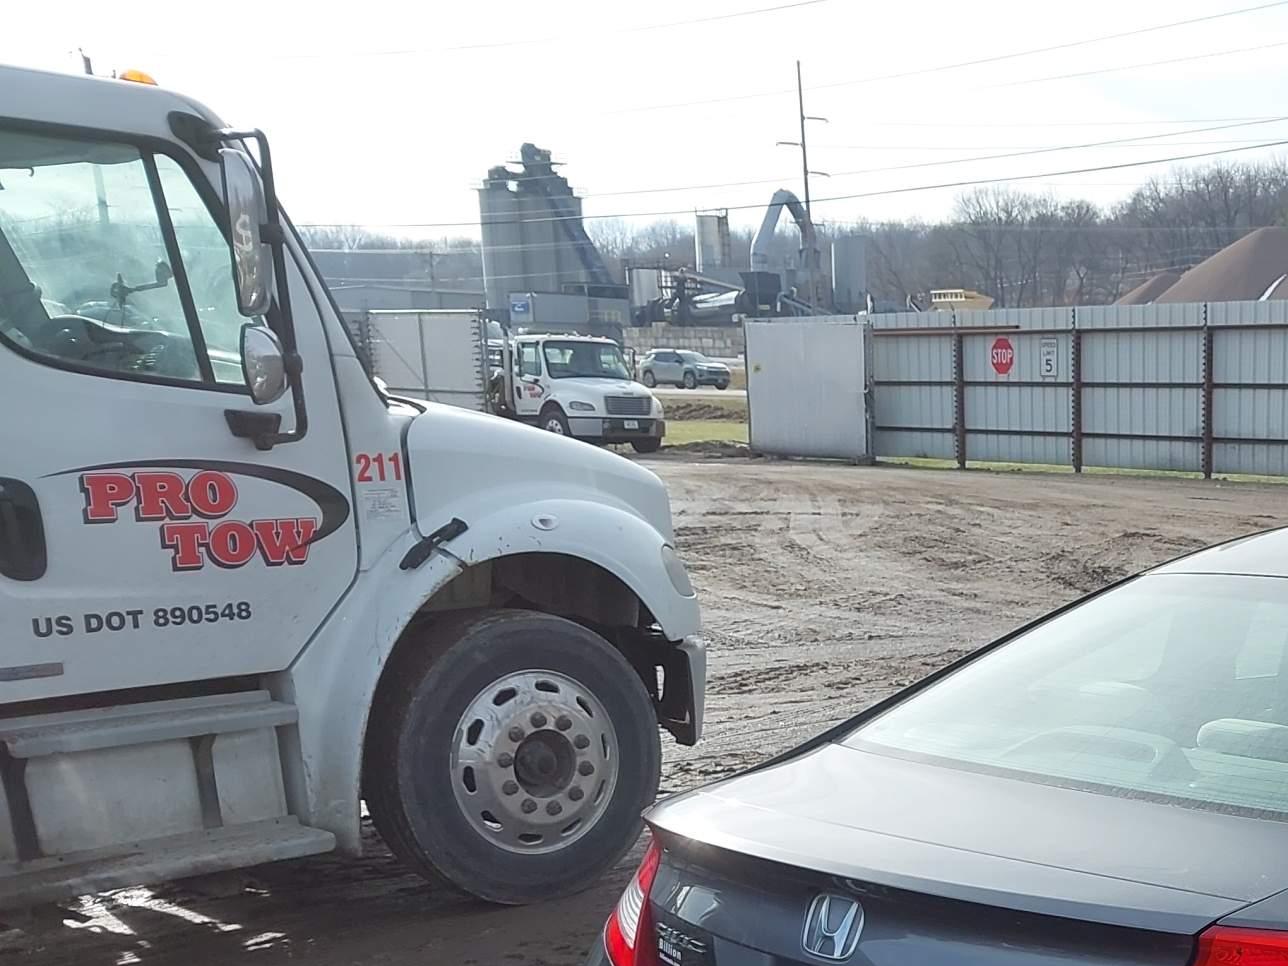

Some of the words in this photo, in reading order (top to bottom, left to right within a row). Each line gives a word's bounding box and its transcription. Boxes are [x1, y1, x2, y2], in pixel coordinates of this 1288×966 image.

[992, 348, 1013, 364] STOP
[1045, 359, 1053, 373] 5
[355, 452, 402, 482] 211
[79, 470, 239, 524] PRO
[161, 517, 317, 572] TOW
[32, 615, 74, 638] US
[84, 609, 144, 634] DOT
[152, 601, 252, 628] 890548
[658, 938, 682, 961] Billion
